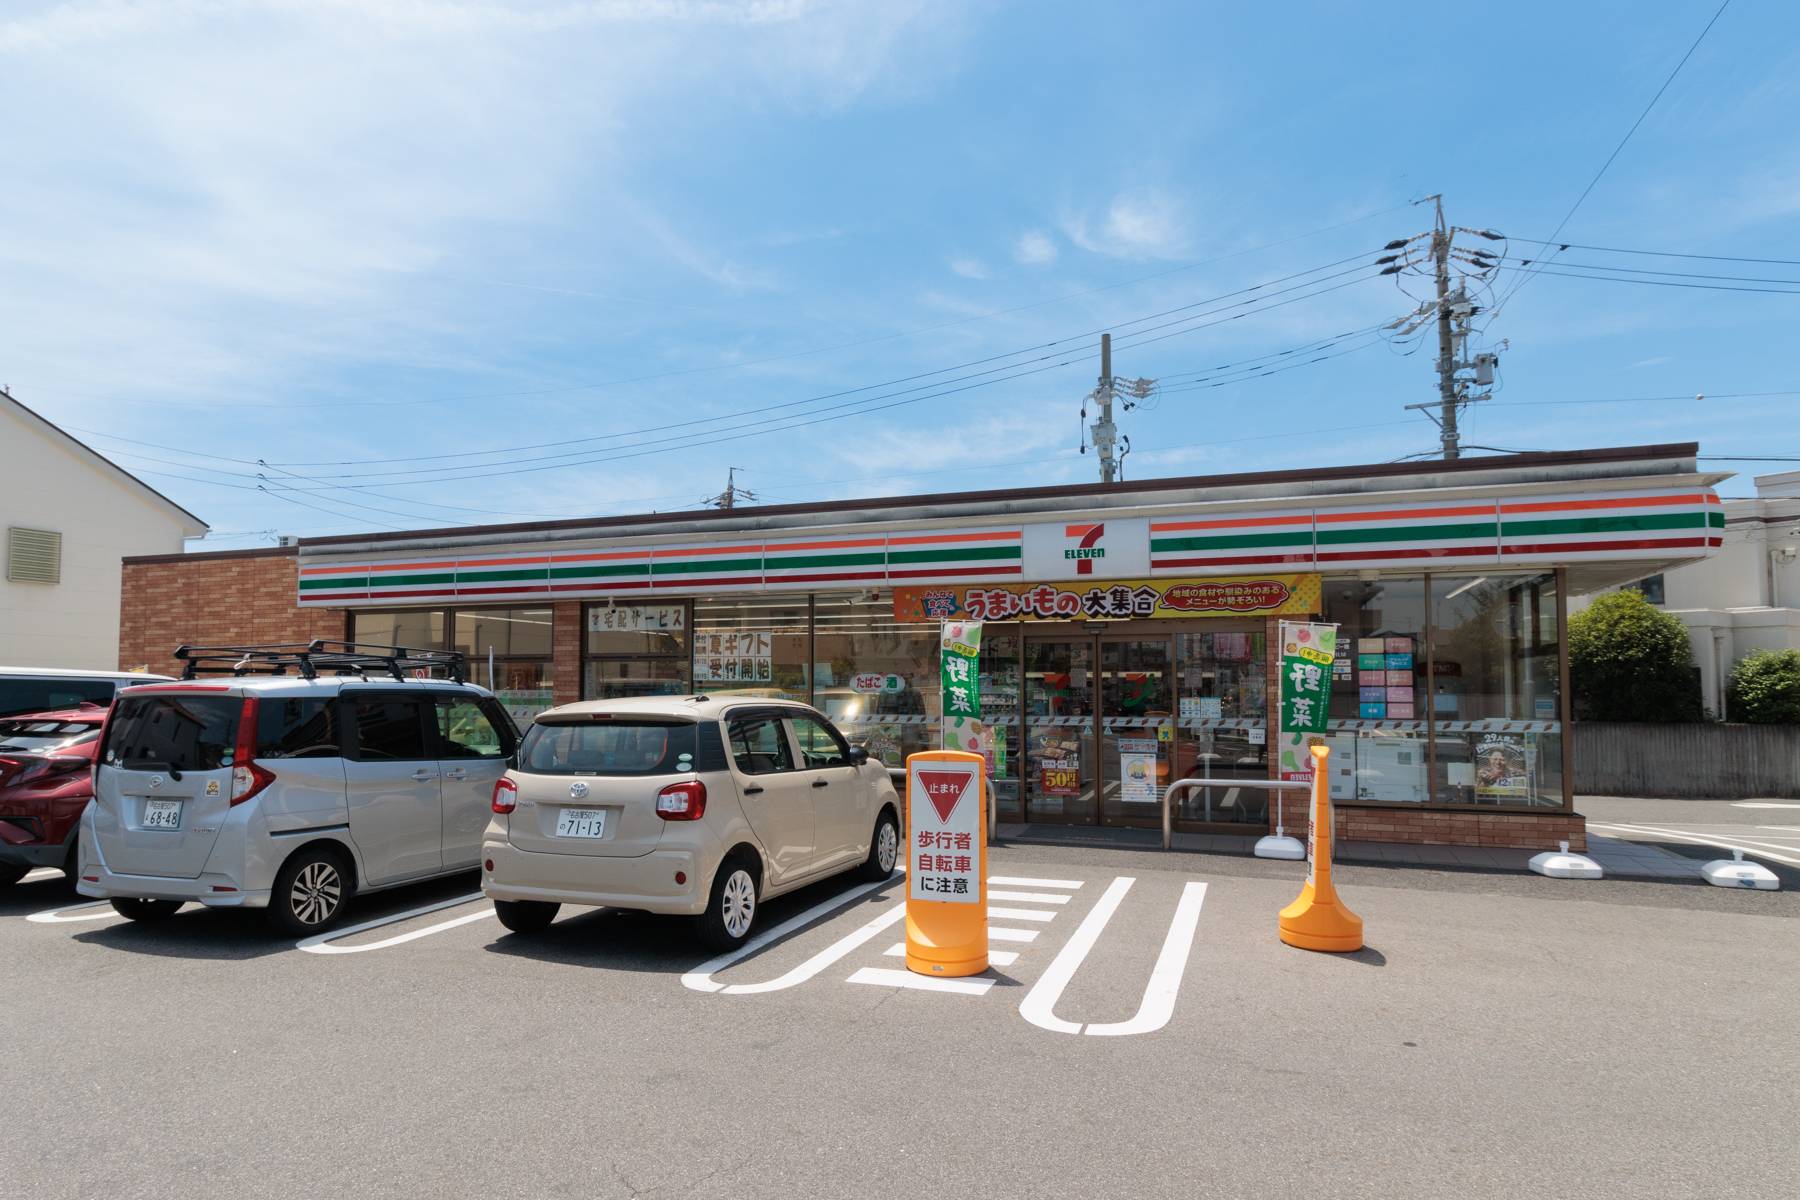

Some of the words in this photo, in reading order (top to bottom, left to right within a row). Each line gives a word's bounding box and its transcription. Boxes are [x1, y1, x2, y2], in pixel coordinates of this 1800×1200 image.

[925, 590, 954, 599] みんなで
[965, 585, 1081, 619] うまいもの
[1083, 586, 1159, 617] 大集合
[928, 599, 950, 608] 食べて
[604, 609, 682, 628] 宅配サービス
[931, 608, 948, 618] 応援
[709, 633, 770, 655] 夏ギフト
[709, 658, 770, 680] 受付開始
[856, 676, 881, 689] たばこ
[886, 676, 898, 689] 酒
[929, 783, 960, 794] 止まれ
[150, 811, 178, 825] 68-48
[566, 820, 602, 836] 71-13
[918, 830, 972, 850] 歩行者
[918, 853, 972, 873] 自転車
[920, 876, 969, 894] に注意
